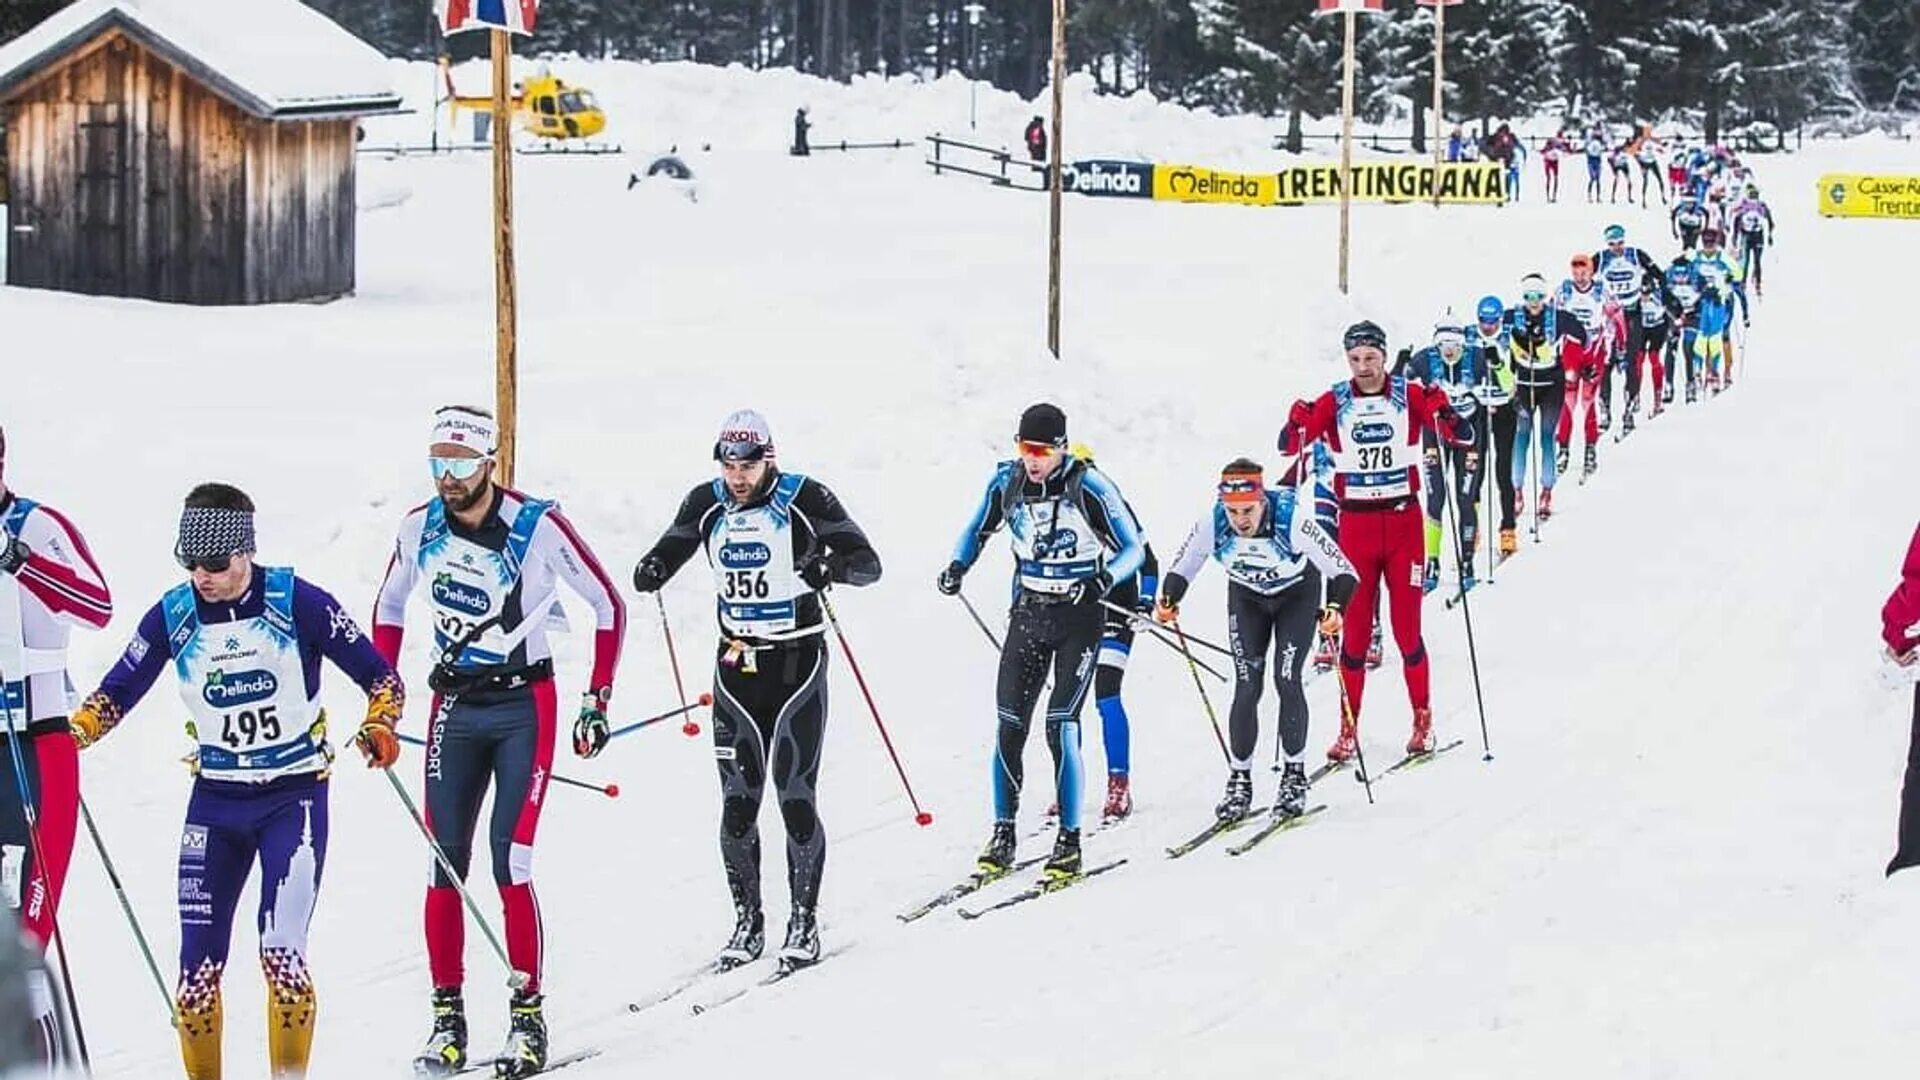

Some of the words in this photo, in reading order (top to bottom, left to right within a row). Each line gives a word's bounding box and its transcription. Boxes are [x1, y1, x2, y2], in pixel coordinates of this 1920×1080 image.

[1169, 171, 1259, 198] Melinda
[1277, 165, 1502, 199] TRENTINGRANA
[1857, 177, 1904, 195] Casse
[1358, 446, 1393, 469] 378
[433, 584, 488, 611] Melinda
[725, 570, 769, 598] 356
[206, 676, 275, 701] Melinda
[222, 706, 281, 748] 495
